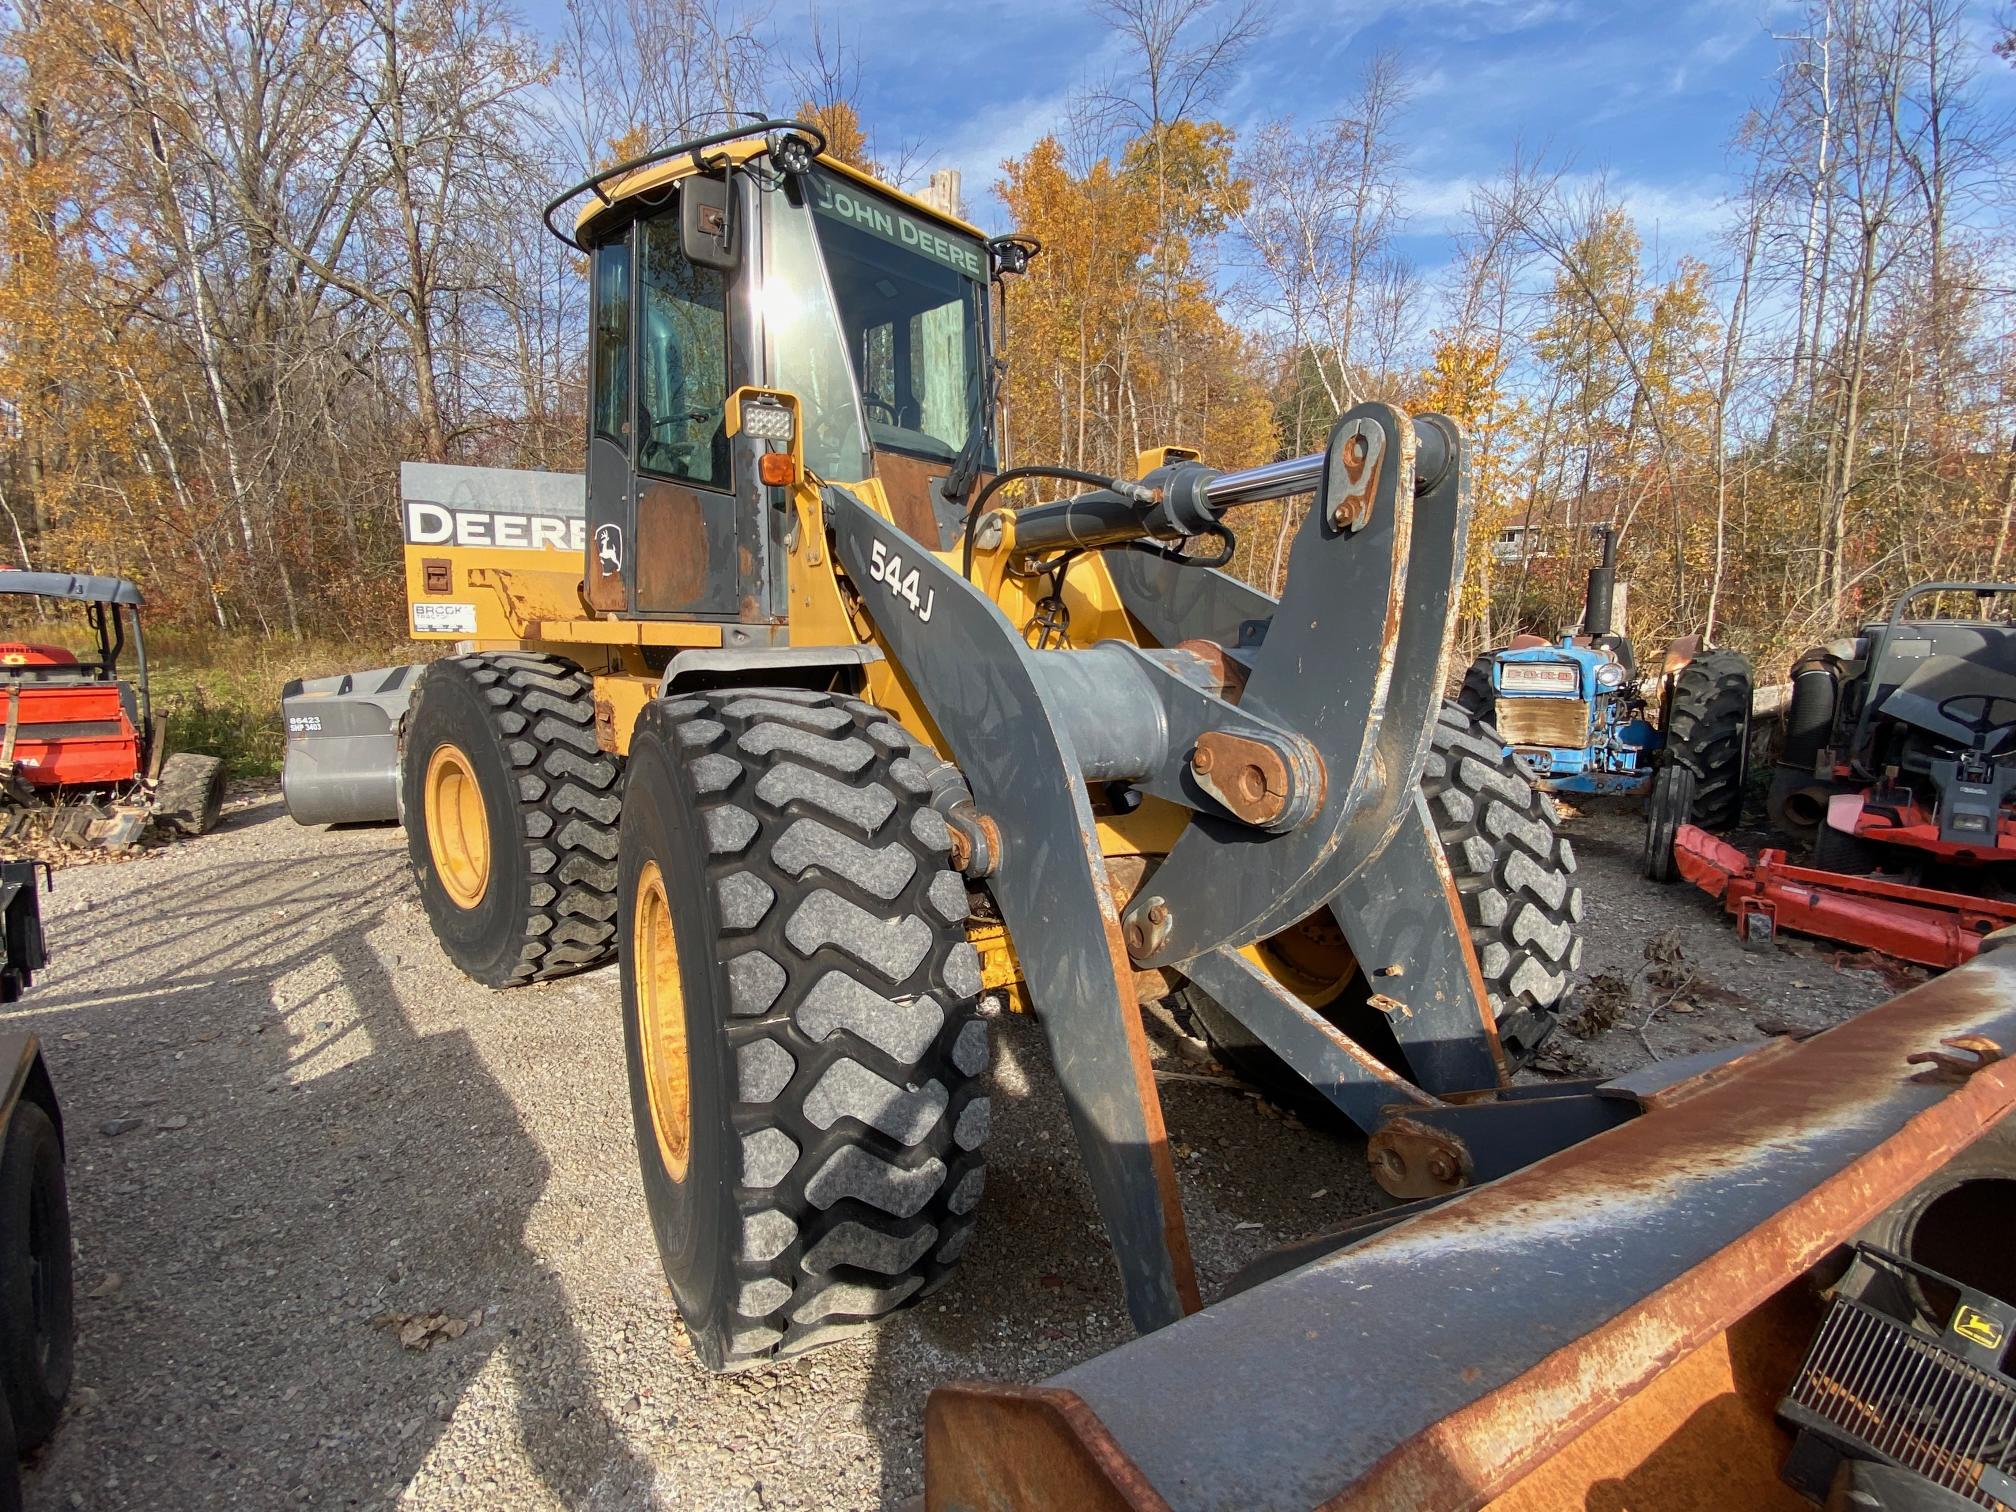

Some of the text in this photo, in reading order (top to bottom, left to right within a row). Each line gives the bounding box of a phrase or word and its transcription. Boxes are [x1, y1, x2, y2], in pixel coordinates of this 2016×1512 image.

[817, 183, 980, 275] JOHN DEERE
[869, 538, 936, 623] 544J
